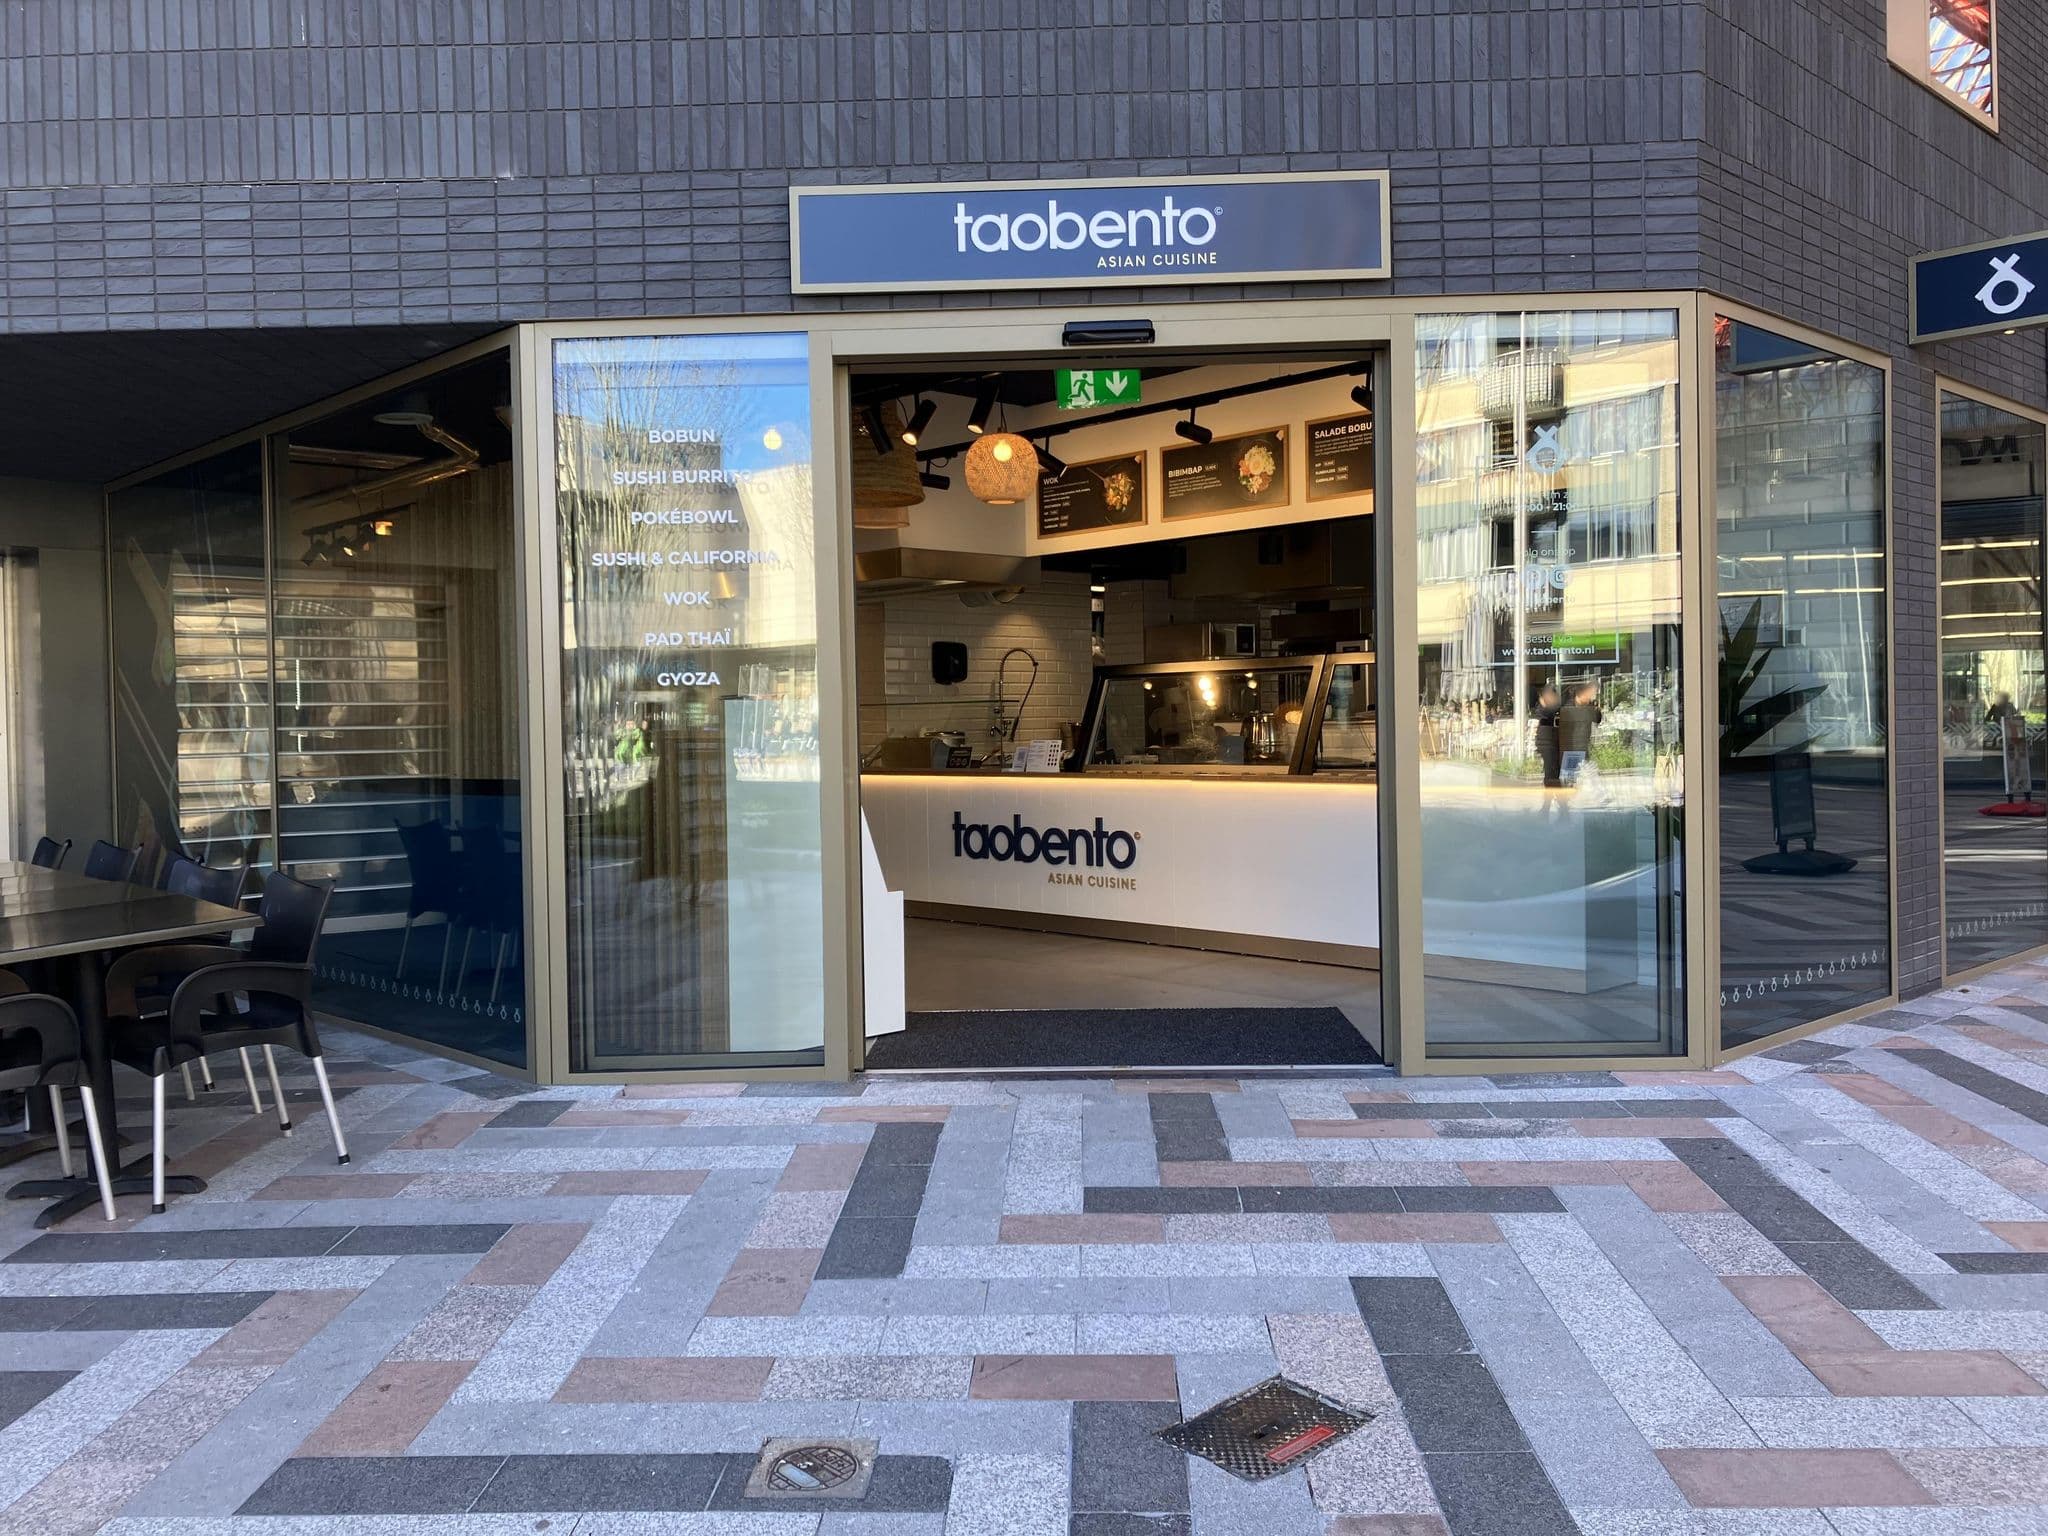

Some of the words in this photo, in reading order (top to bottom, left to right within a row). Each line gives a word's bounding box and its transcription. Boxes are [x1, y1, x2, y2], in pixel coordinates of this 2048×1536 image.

[1097, 254, 1146, 269] ASIAN
[1152, 252, 1217, 266] CUISINE
[648, 429, 716, 444] BOBUN
[1314, 426, 1347, 439] SALADE
[612, 470, 666, 486] SUSHI
[1168, 465, 1203, 478] BIBIMBAP
[631, 507, 738, 526] POKÉBOWL
[591, 552, 647, 567] SUSHI
[652, 551, 664, 566] &
[668, 550, 780, 565] CALIFORNIA
[663, 591, 711, 606] WOK
[645, 632, 683, 647] PAD
[687, 628, 731, 645] THAÏ
[657, 672, 721, 687] GYOZA
[1047, 871, 1083, 887] ASIAN
[1087, 875, 1137, 891] CUISINE
